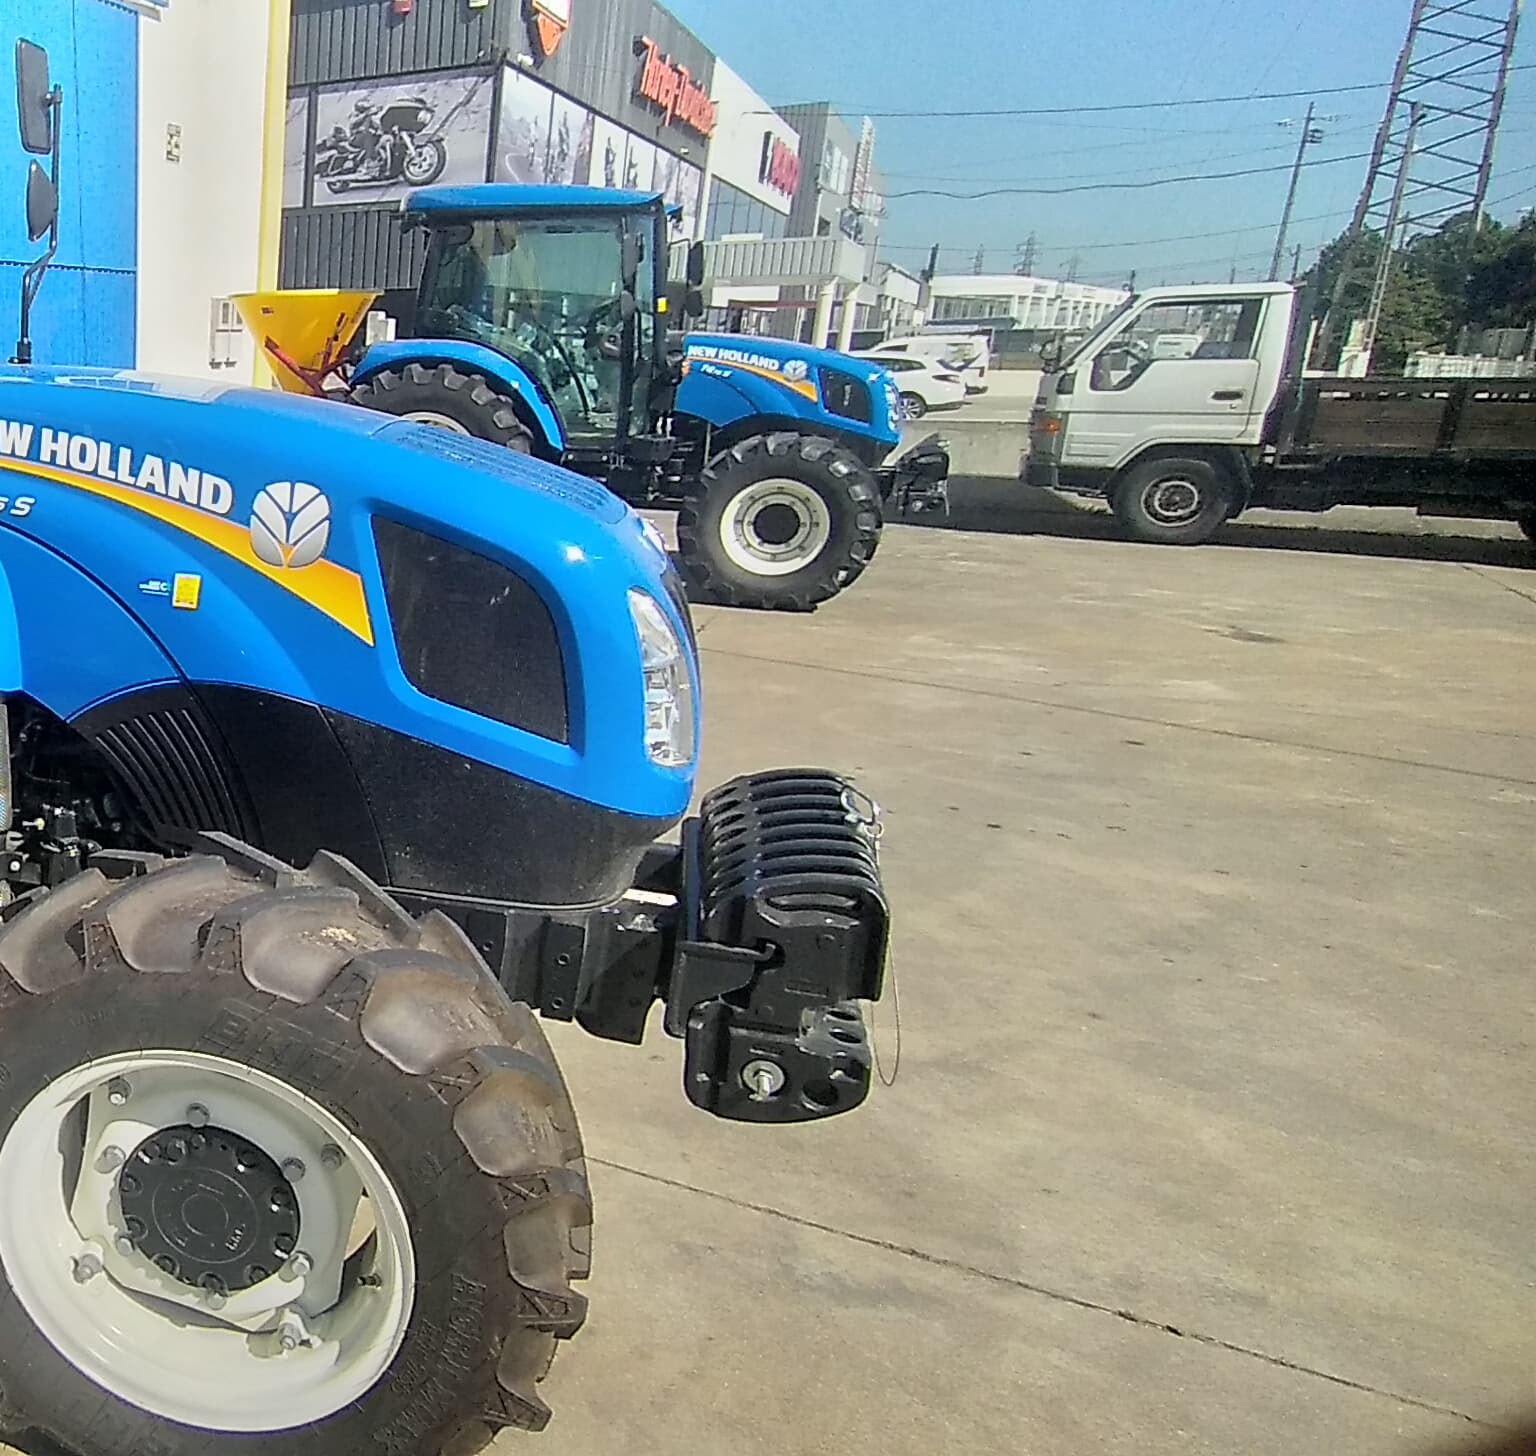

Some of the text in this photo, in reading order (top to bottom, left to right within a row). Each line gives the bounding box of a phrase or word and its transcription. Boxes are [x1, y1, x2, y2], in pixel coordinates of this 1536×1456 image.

[687, 345, 780, 371] NEW HOLLAND
[39, 427, 233, 514] HOLLAND
[10, 496, 35, 516] S
